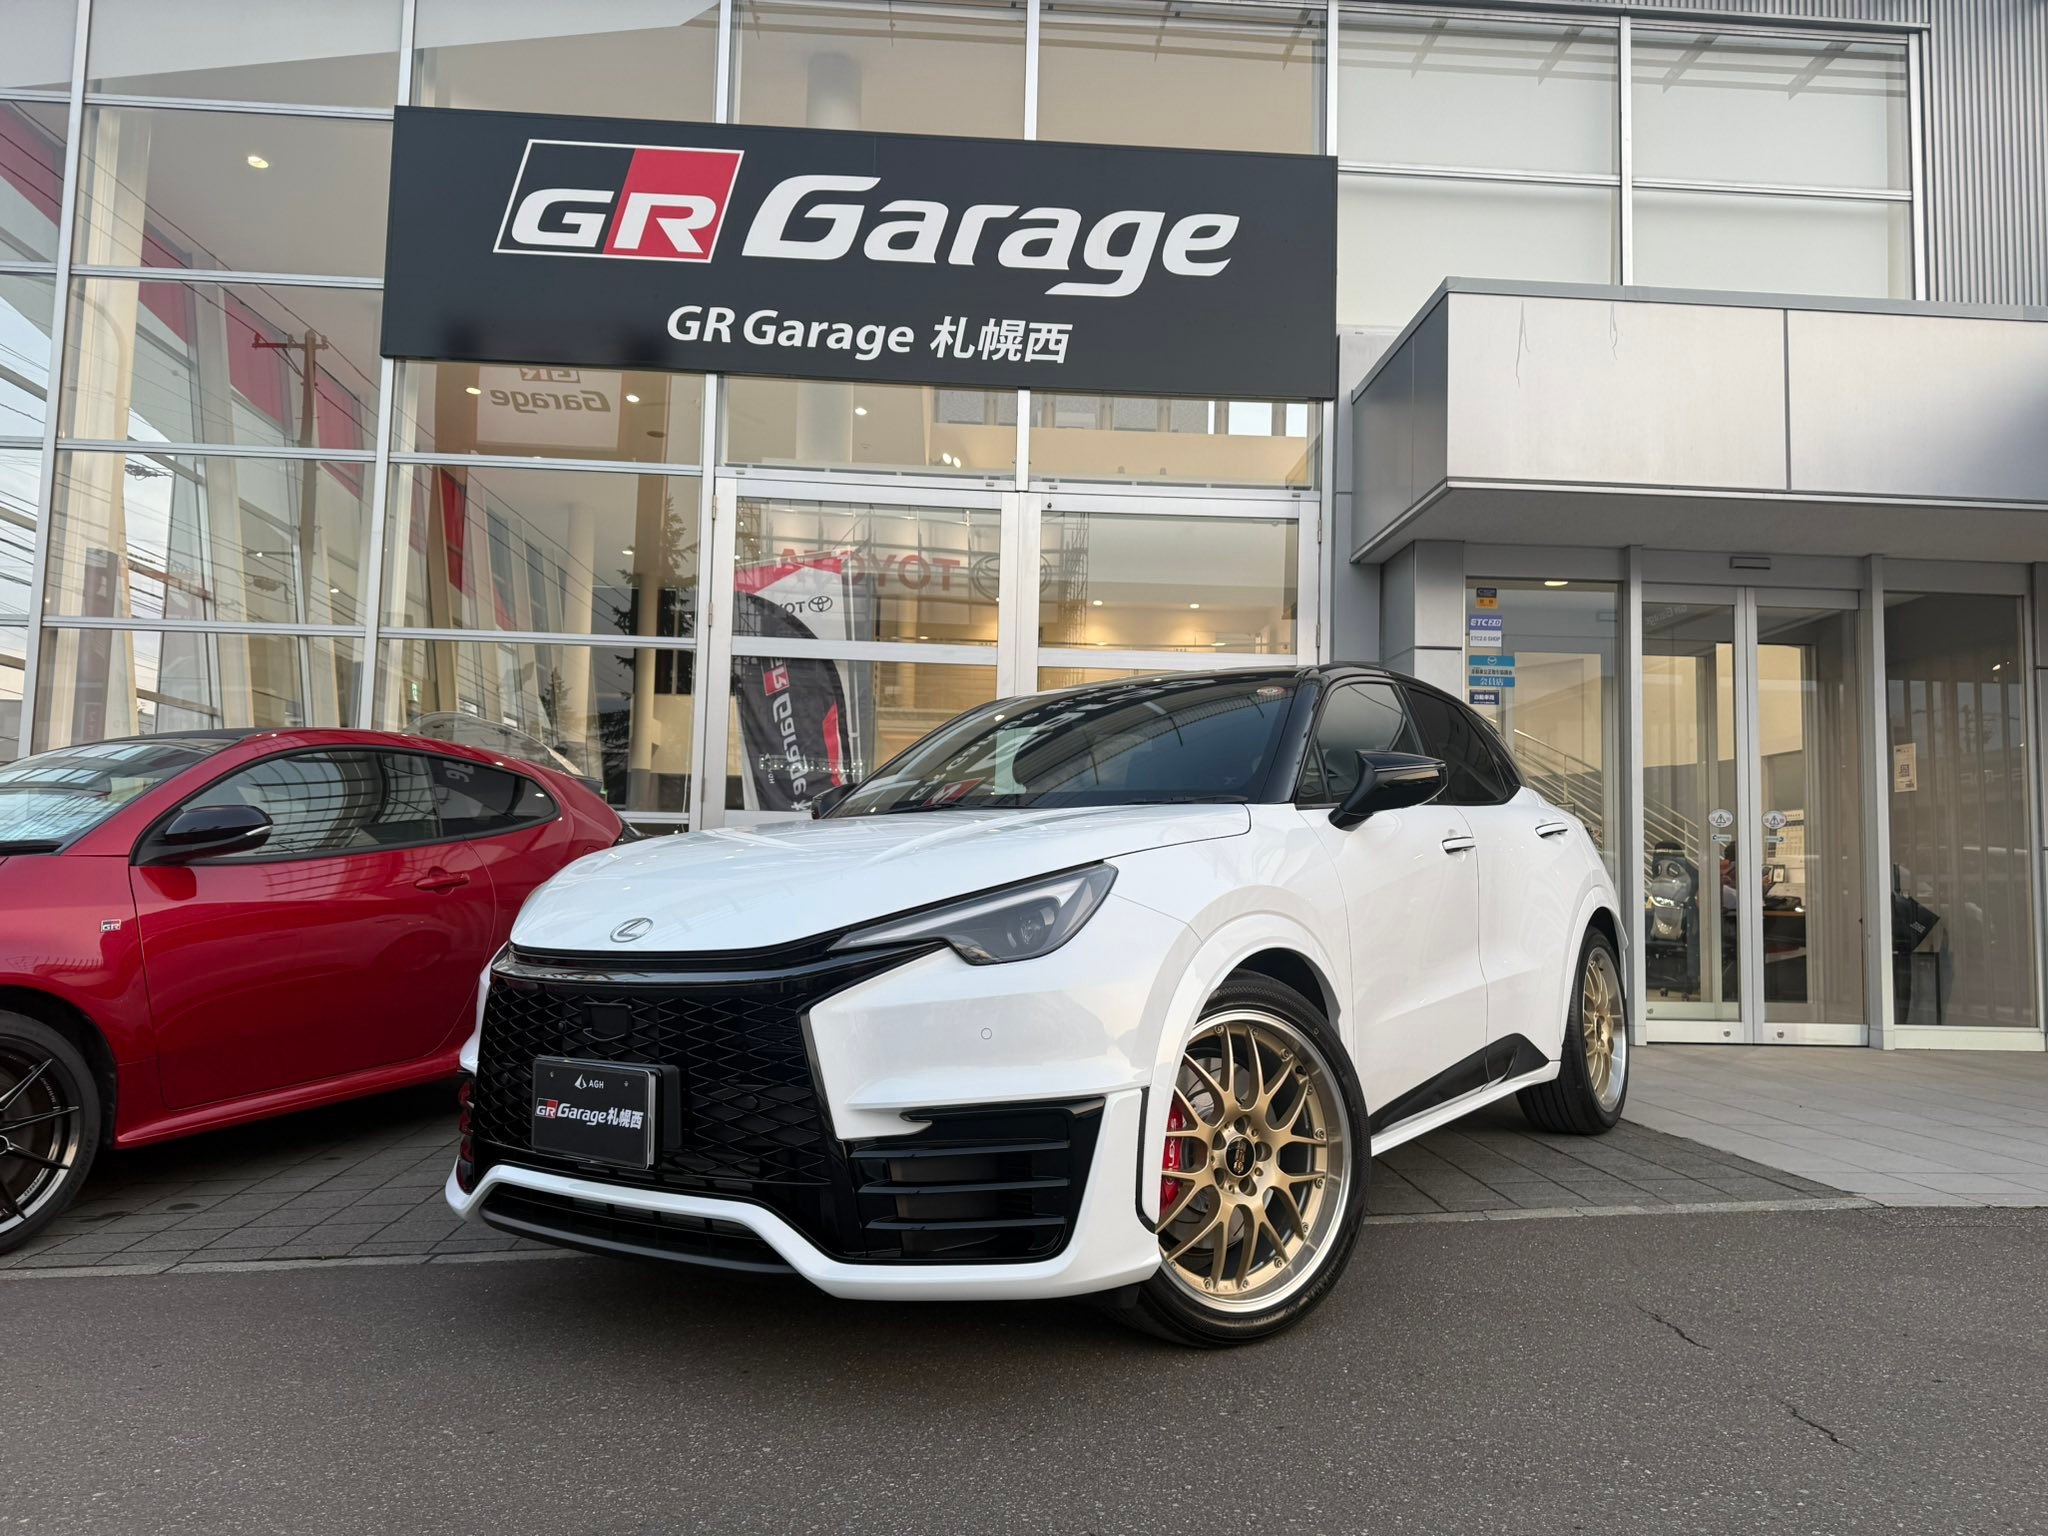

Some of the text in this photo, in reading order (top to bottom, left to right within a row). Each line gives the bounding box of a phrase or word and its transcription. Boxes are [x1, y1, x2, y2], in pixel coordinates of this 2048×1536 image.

[511, 175, 1240, 298] GR Garage
[667, 305, 1073, 364] GR Garage 札幌西
[588, 1079, 604, 1089] AGH
[534, 1104, 557, 1119] GR
